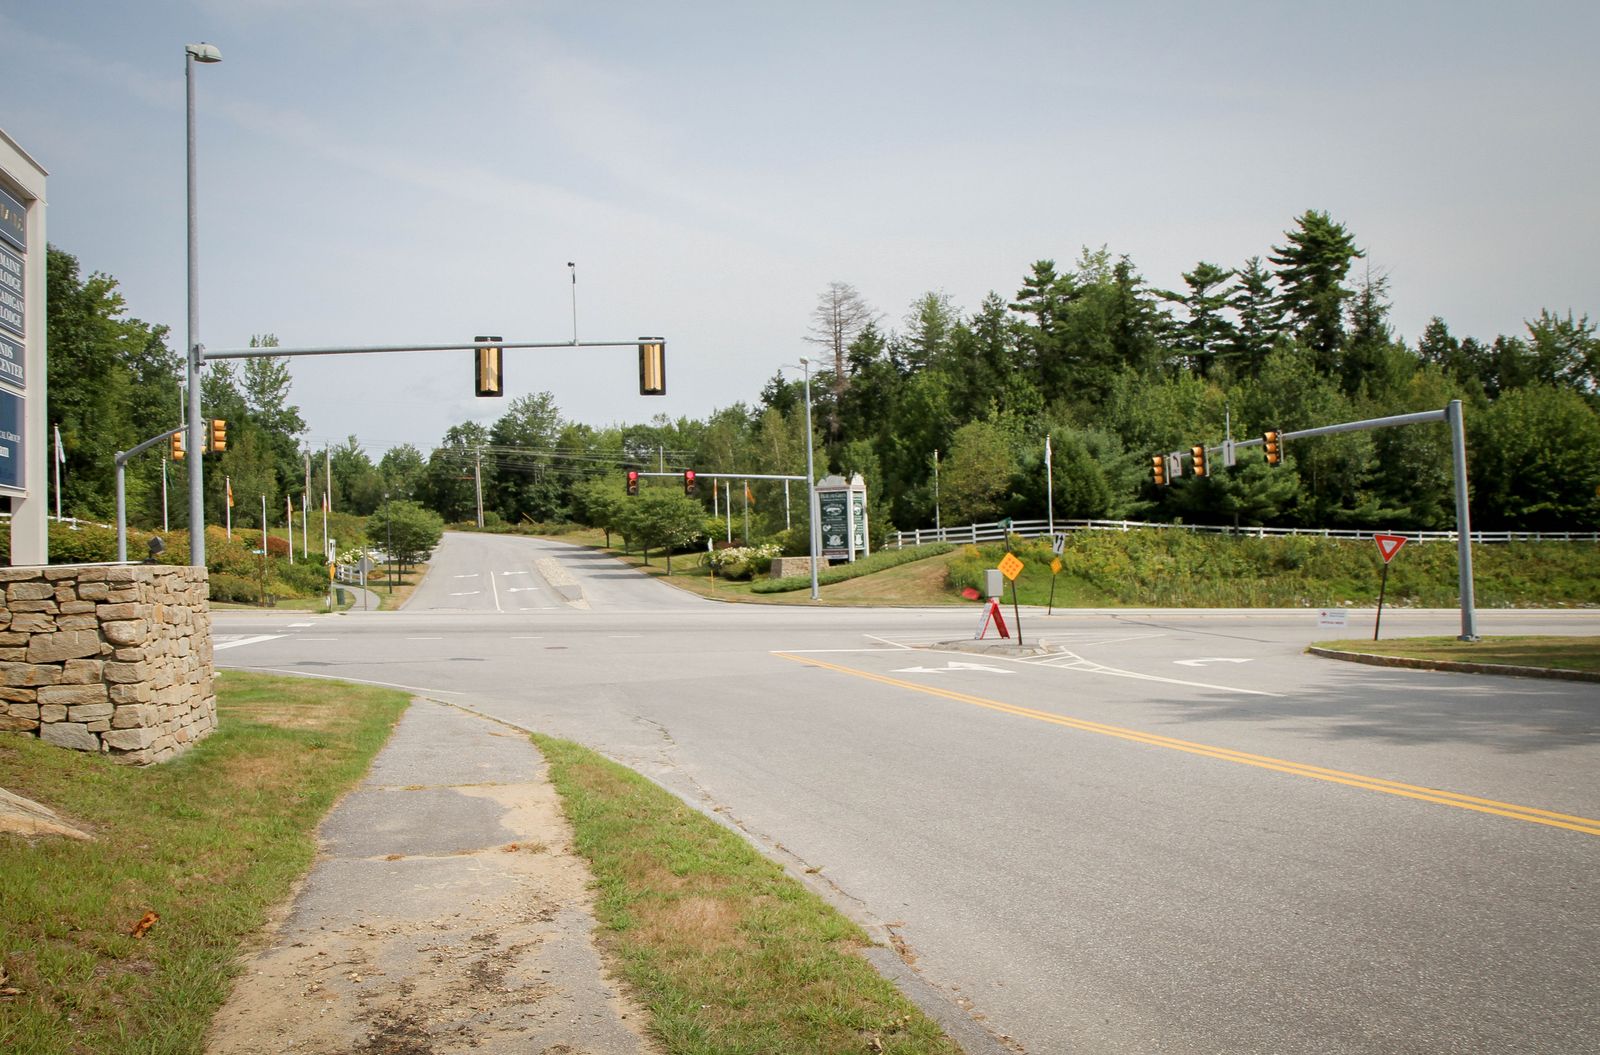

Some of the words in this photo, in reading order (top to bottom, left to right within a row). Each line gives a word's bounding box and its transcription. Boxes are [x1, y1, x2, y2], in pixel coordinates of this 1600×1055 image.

[0, 268, 21, 292] LODGE
[0, 288, 24, 315] ADIGAN
[0, 306, 21, 328] LODGE
[0, 356, 23, 379] ENTER
